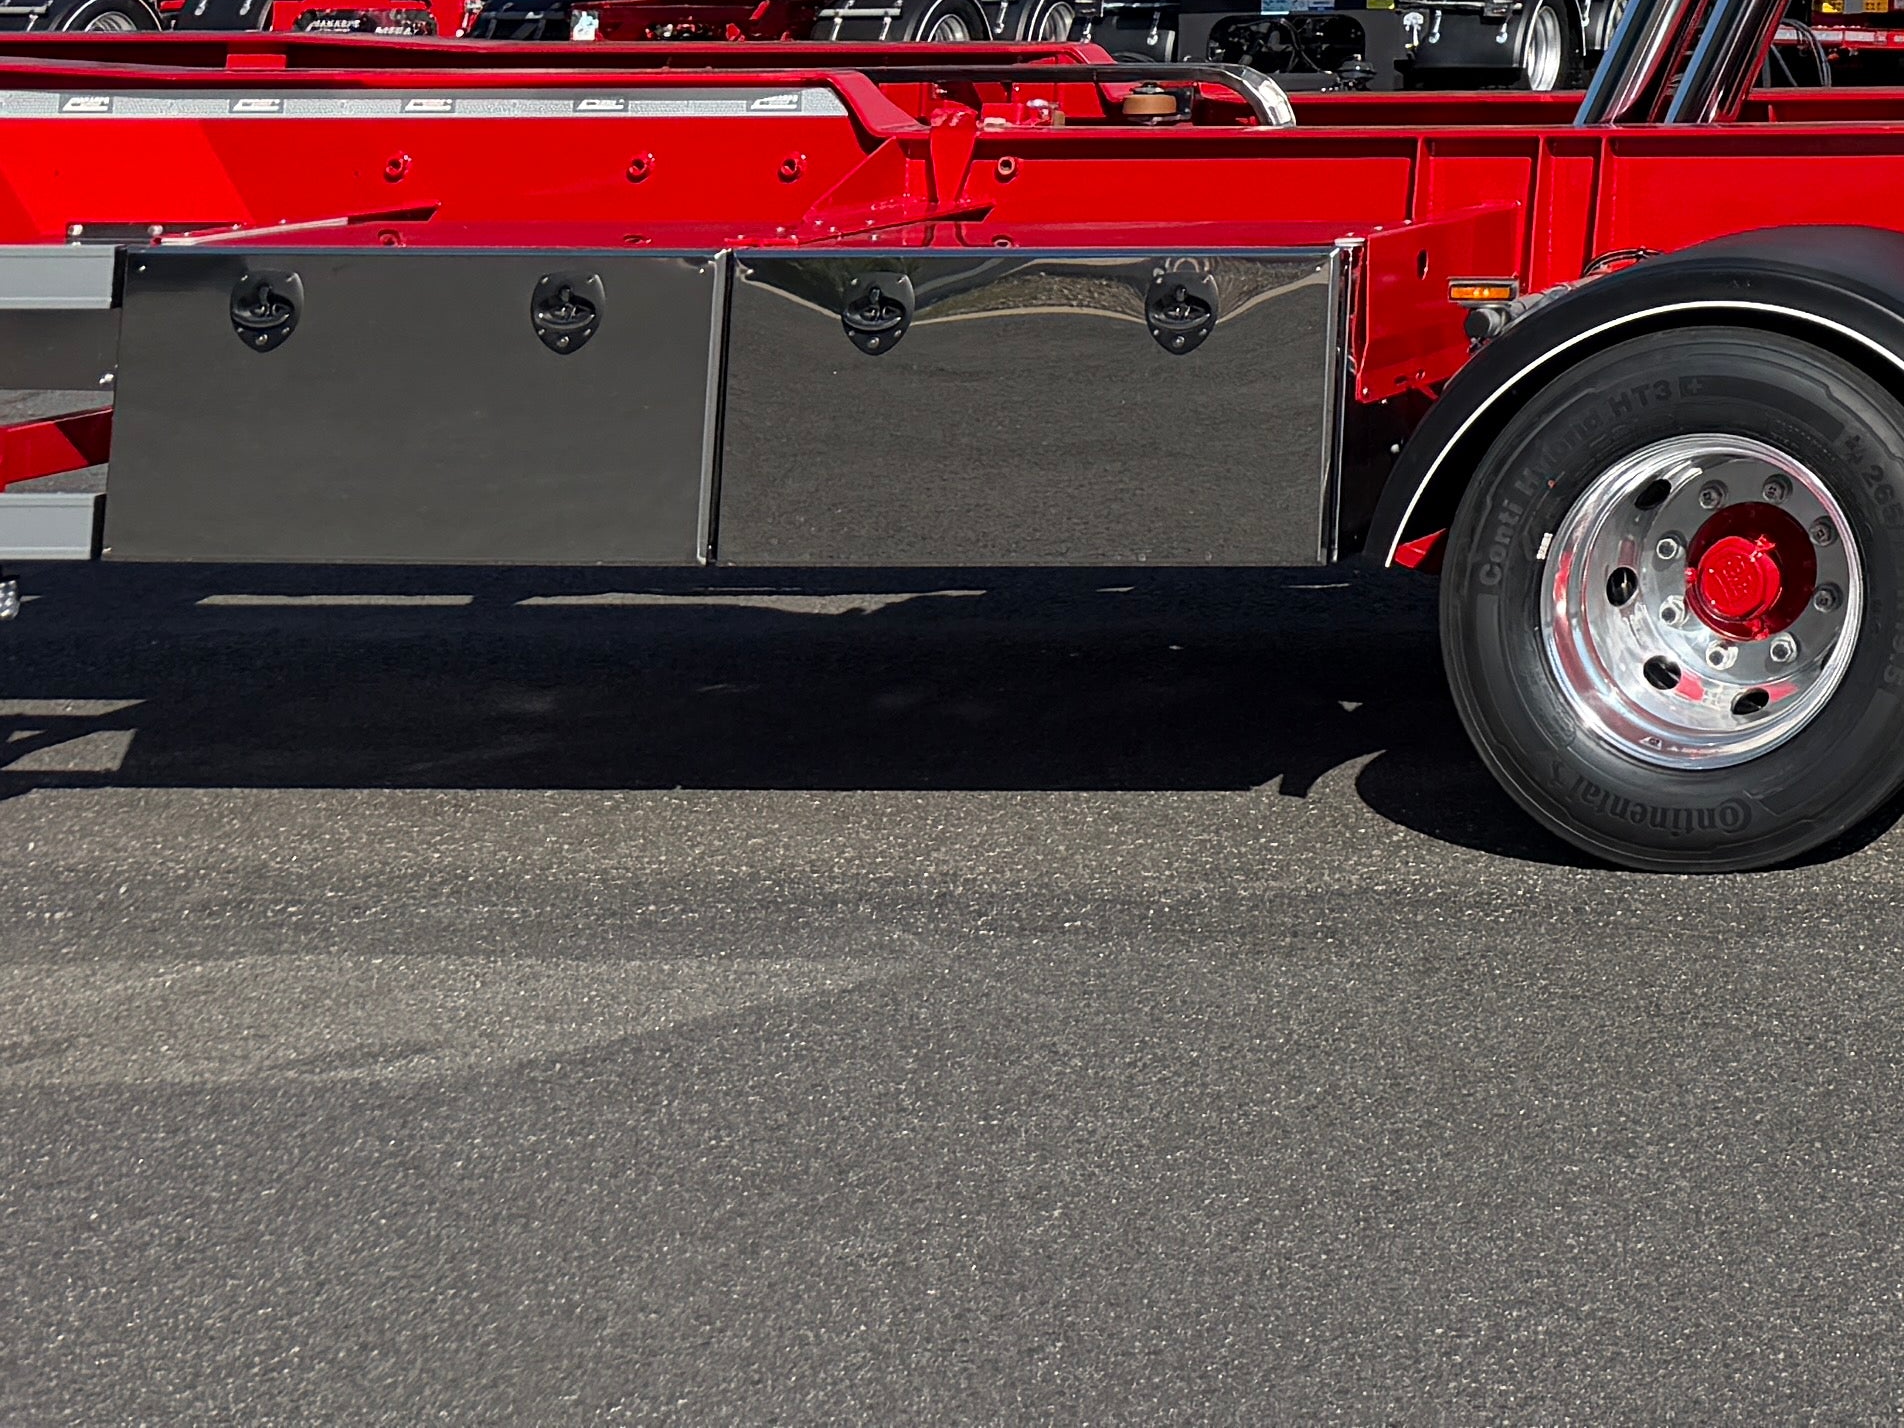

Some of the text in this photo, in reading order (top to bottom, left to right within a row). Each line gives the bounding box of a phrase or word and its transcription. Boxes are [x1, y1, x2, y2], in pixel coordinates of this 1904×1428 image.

[1478, 498, 1525, 586] Conti
[1513, 405, 1608, 498] Hybrid
[1574, 775, 1753, 836] Continental
